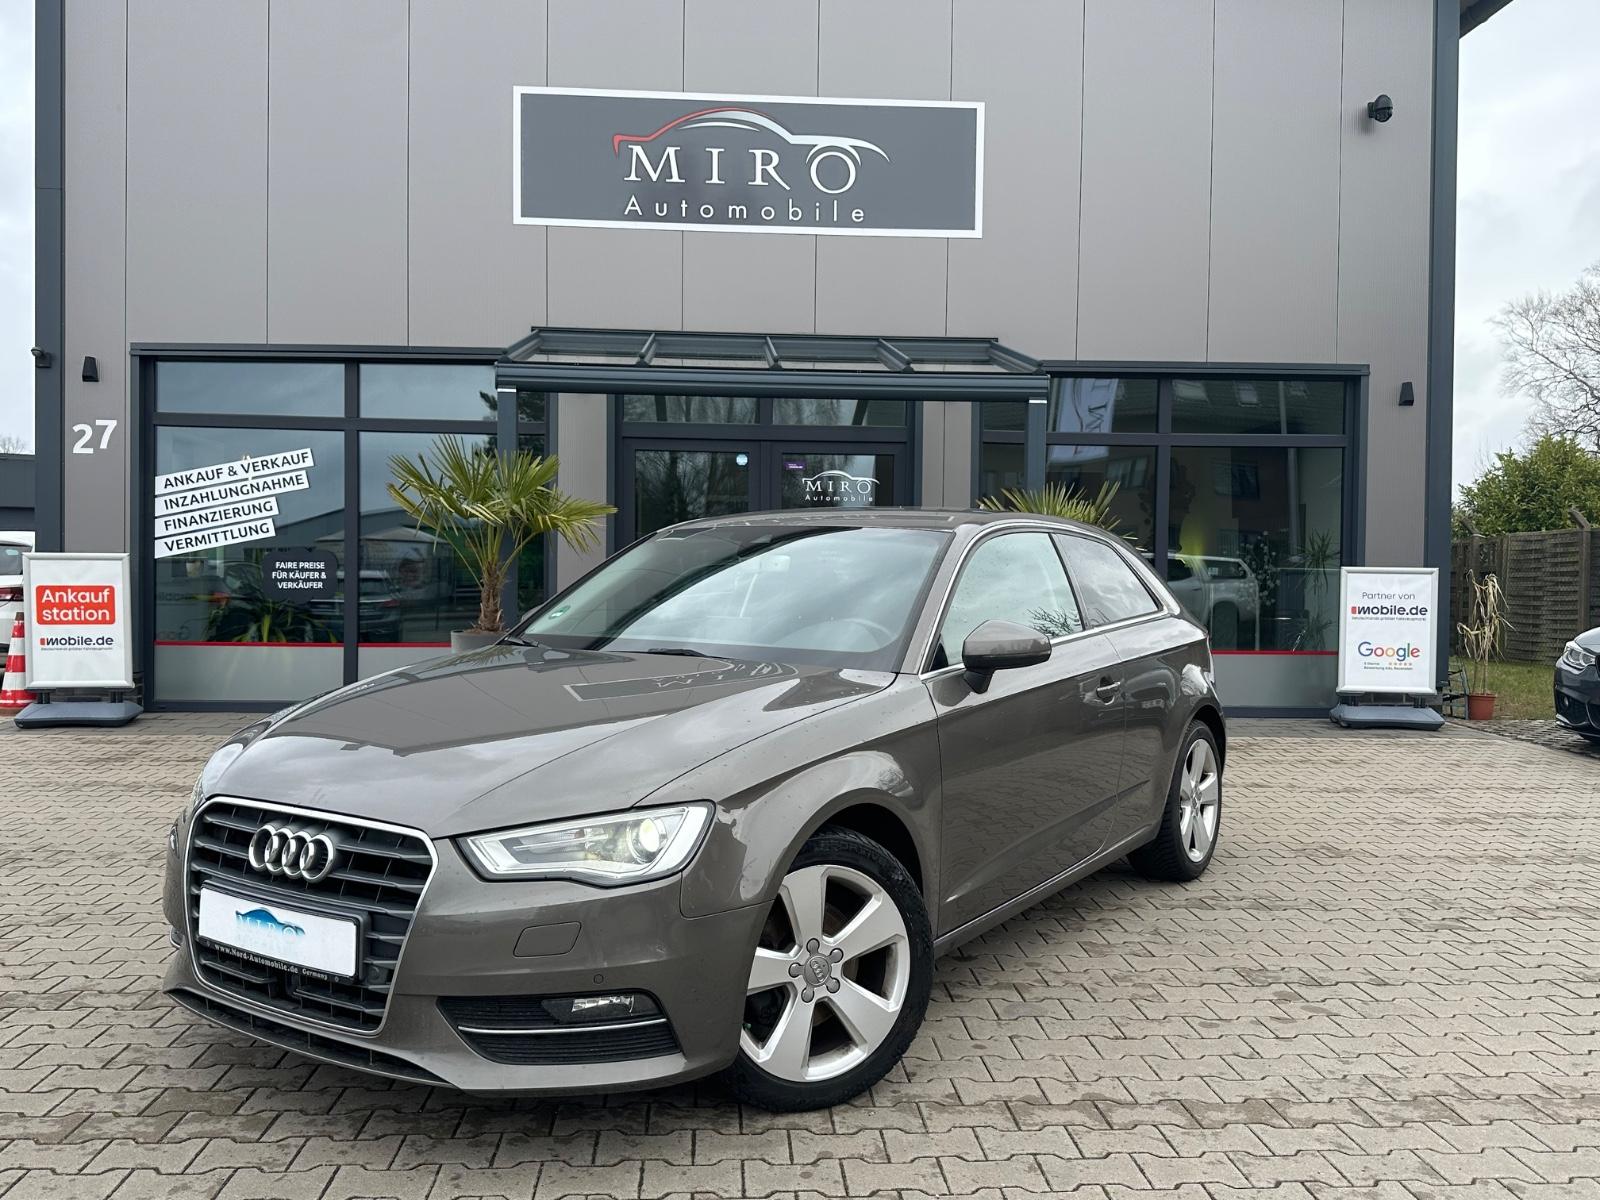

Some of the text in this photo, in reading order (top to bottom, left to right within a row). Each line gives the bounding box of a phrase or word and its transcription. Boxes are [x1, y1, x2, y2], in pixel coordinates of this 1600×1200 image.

[624, 145, 857, 194] MIRO
[624, 194, 864, 222] Automobile
[72, 419, 117, 454] 27
[164, 452, 309, 489] ANKAUF & VERKAUF
[164, 474, 305, 510] INZAHLUNGNAHME
[805, 480, 871, 494] MIRO
[805, 494, 873, 502] Automobile
[164, 501, 273, 531] FINANZIERUNG
[164, 522, 270, 552] VERMITTLUNG
[275, 561, 325, 570] FAIRE PREISE
[271, 570, 327, 580] FÜR KÄUFER &
[277, 580, 323, 590] VERKÄUFER
[41, 588, 110, 604] Ankauf
[1362, 592, 1396, 600] Partner
[42, 605, 110, 621] station
[1357, 604, 1428, 616] mobile.de
[46, 636, 114, 646] mobile.de
[1357, 641, 1420, 662] Google
[214, 944, 328, 981] www.Nord-Automobile.de Germany
